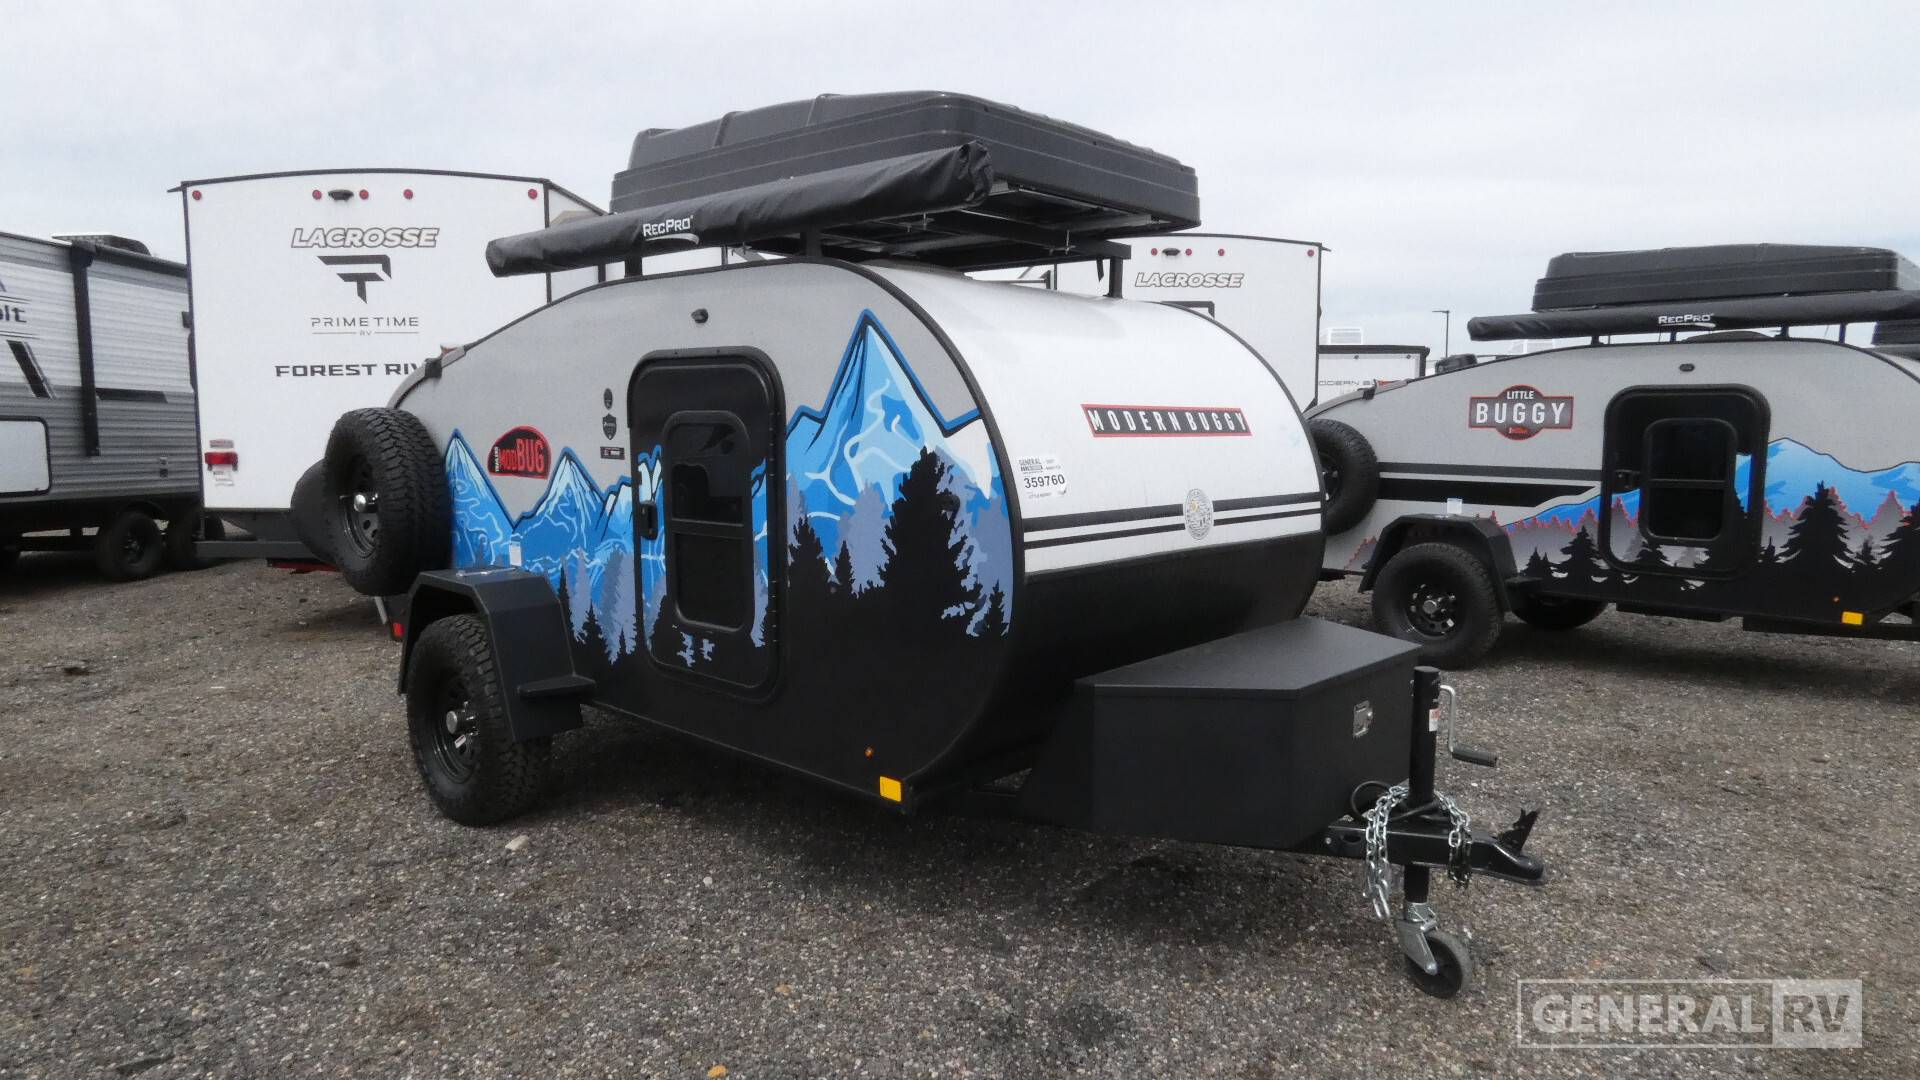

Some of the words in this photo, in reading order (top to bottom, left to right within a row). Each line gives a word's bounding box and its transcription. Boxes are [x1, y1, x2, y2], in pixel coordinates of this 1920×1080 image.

[290, 227, 440, 248] LACROSSE
[1134, 272, 1245, 288] LACROSSE
[311, 317, 369, 327] PRIME
[373, 317, 419, 327] TIME
[275, 364, 377, 377] FOREST
[1506, 390, 1535, 400] LITTLE
[1087, 409, 1181, 431] MODERN
[1185, 411, 1247, 431] BUGGY
[1475, 402, 1565, 424] BUGGY
[1023, 474, 1065, 488] 359760
